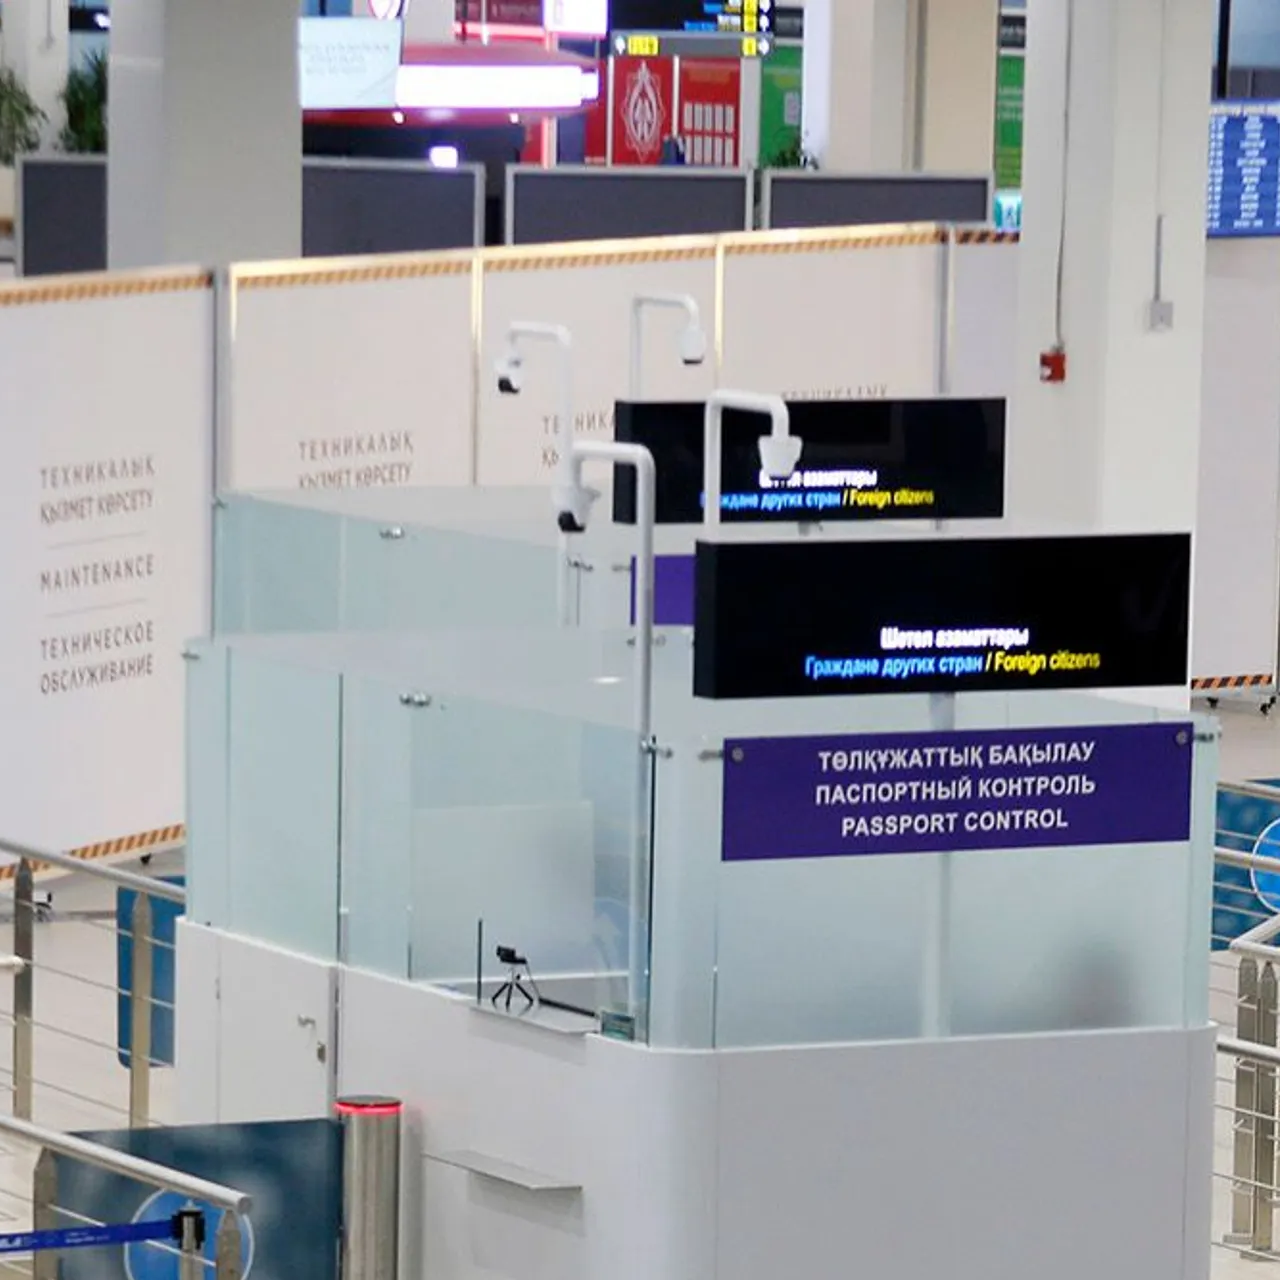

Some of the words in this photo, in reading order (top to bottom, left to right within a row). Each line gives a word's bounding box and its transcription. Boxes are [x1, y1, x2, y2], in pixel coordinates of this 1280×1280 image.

[40, 554, 154, 592] MAINTENANCE
[40, 620, 154, 661] ТЕХНИЧЕСКОЕ
[40, 653, 154, 695] ОБСЛУЖИВАНИЕ
[805, 655, 879, 679] Граждане
[882, 655, 934, 678] других
[938, 656, 982, 676] стран
[994, 651, 1046, 675] Foreign
[1050, 650, 1100, 669] citizens
[818, 746, 984, 773] ТӨЛҚҰЖАТТЫҚ
[988, 741, 1095, 767] БАҚЫЛАУ
[815, 775, 972, 806] ПАСПОРТНЫЙ
[978, 774, 1096, 799] КОНТРОЛЬ
[841, 813, 958, 838] PASSPORT
[963, 808, 1069, 832] CONTROL
